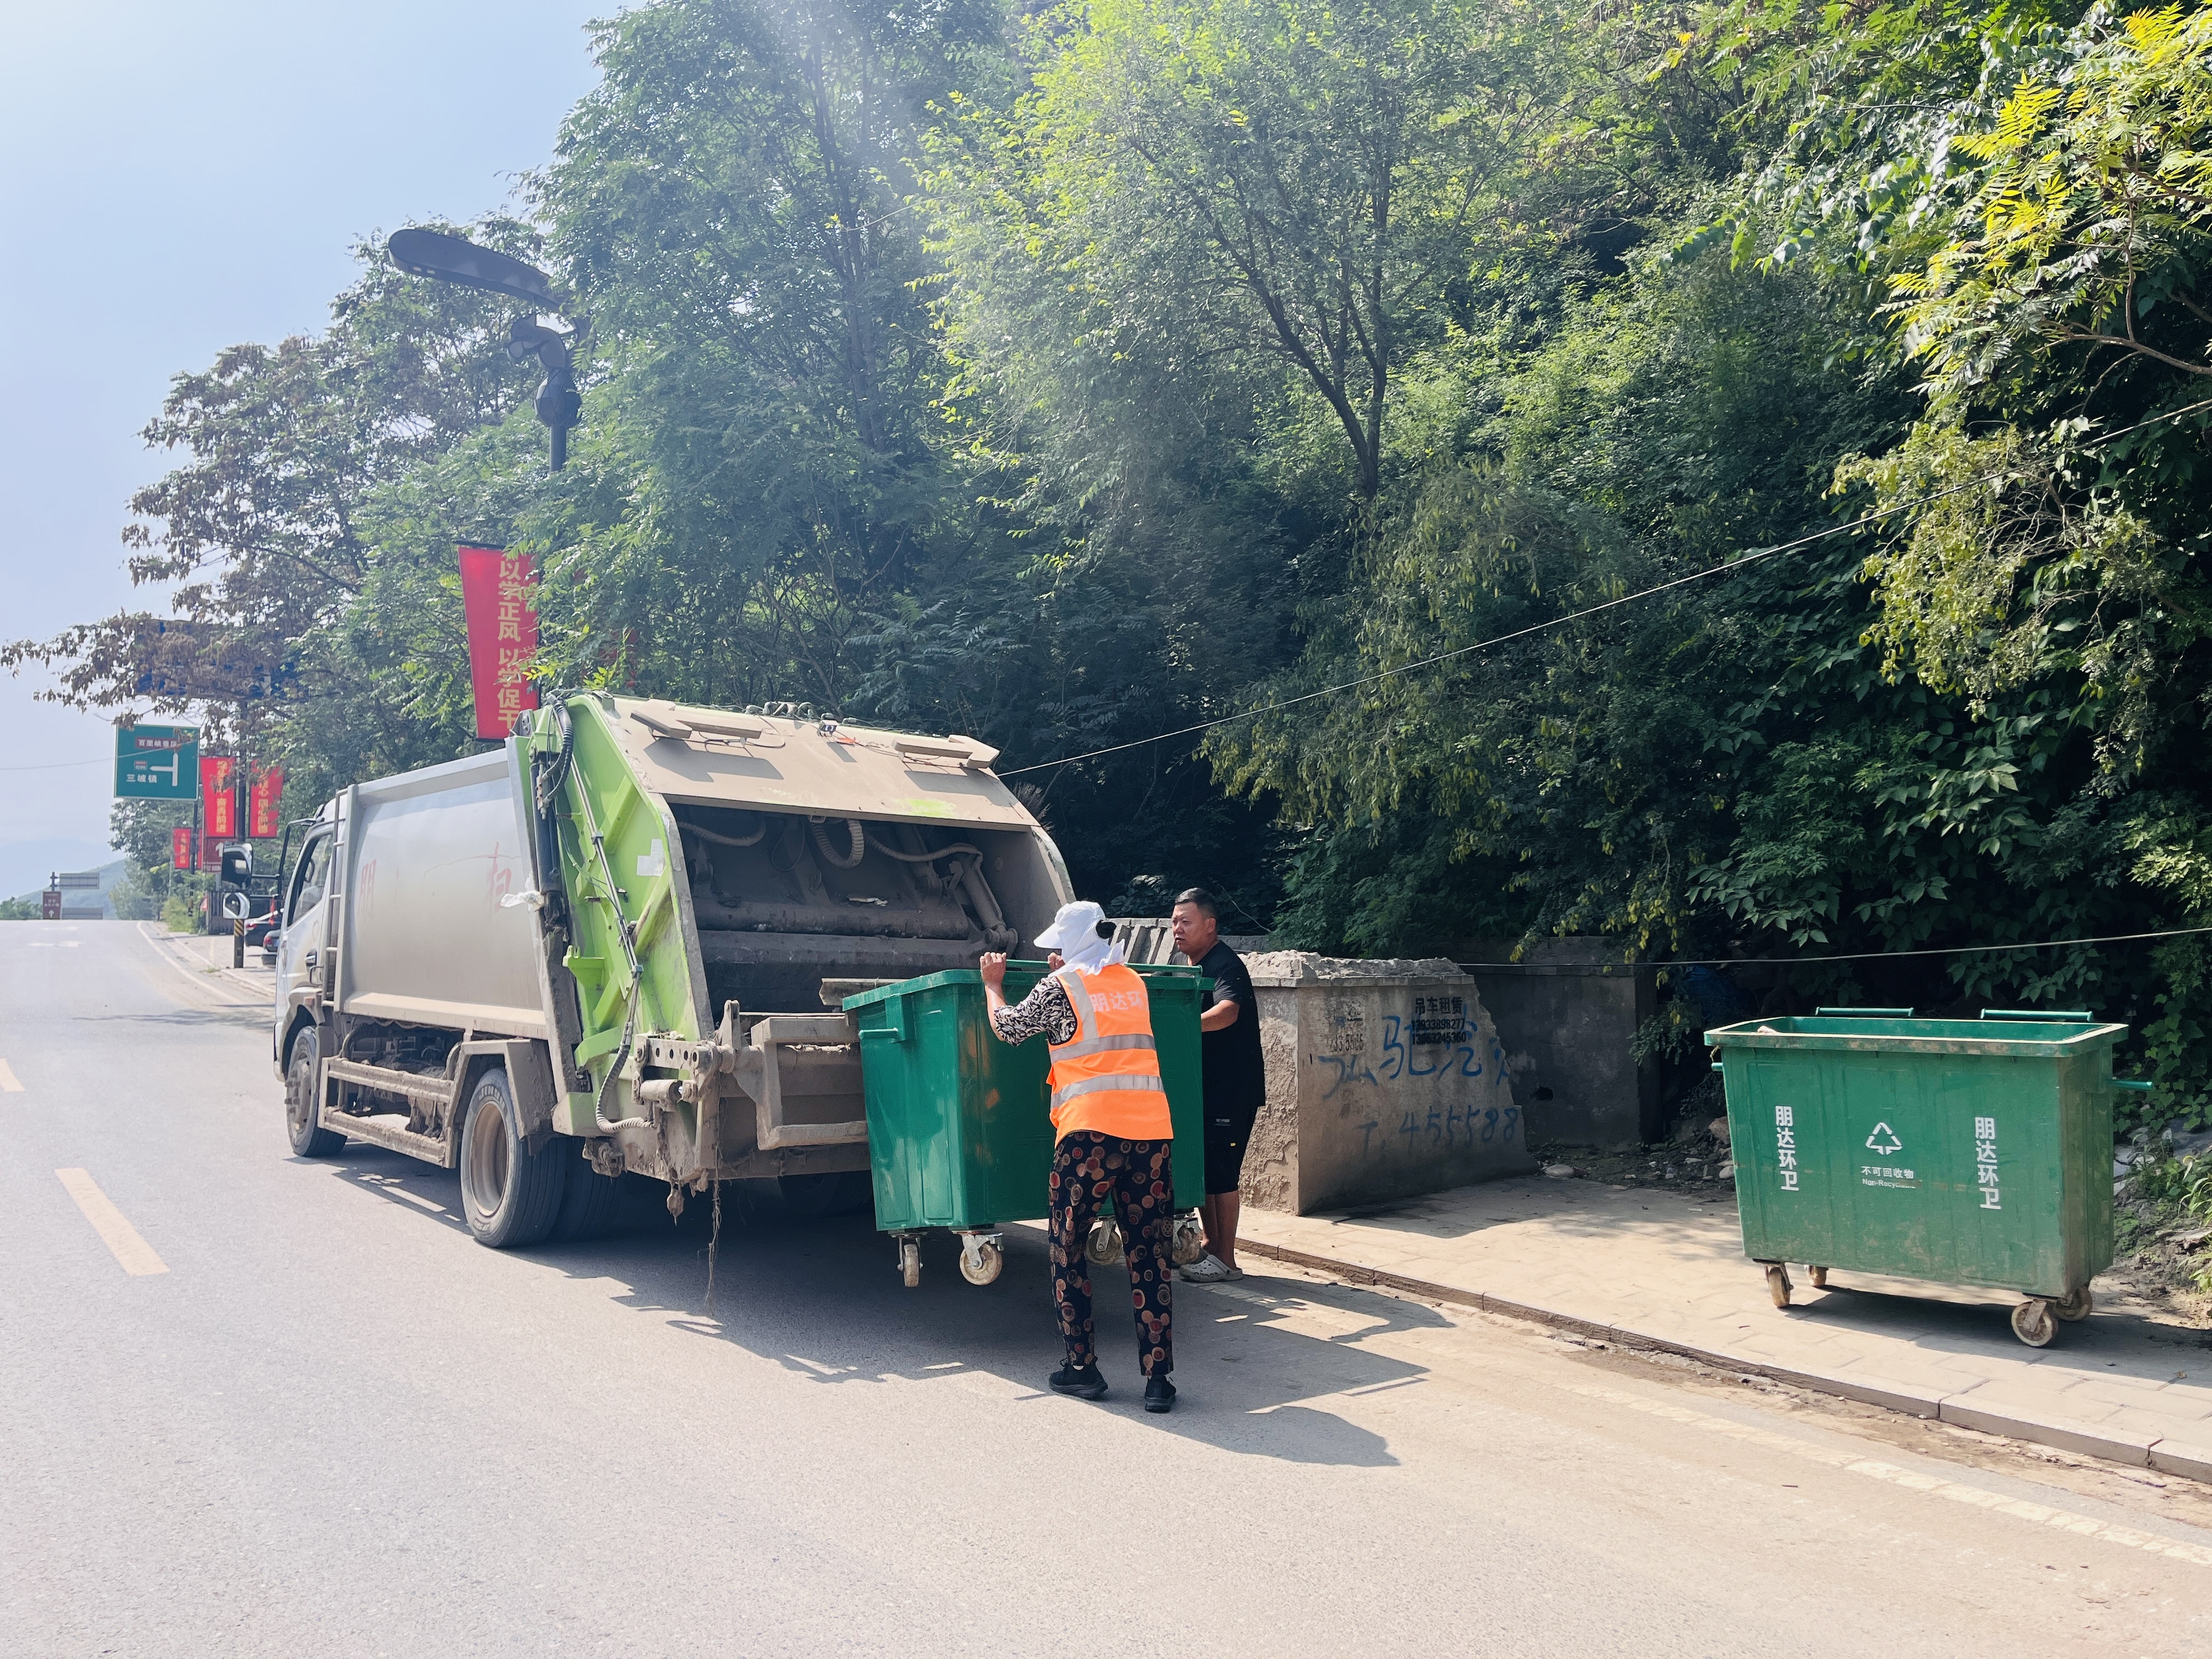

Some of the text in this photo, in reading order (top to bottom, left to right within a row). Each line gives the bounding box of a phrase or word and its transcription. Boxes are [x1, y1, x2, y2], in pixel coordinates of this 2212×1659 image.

[498, 560, 522, 642] 以学正风
[1088, 991, 1148, 1012] 朋达环
[1415, 996, 1463, 1015] 吊车租赁
[1775, 1105, 1799, 1191] 朋达环卫
[1860, 1166, 1914, 1179] 不可回收物
[1975, 1116, 2001, 1210] 朋达环卫
